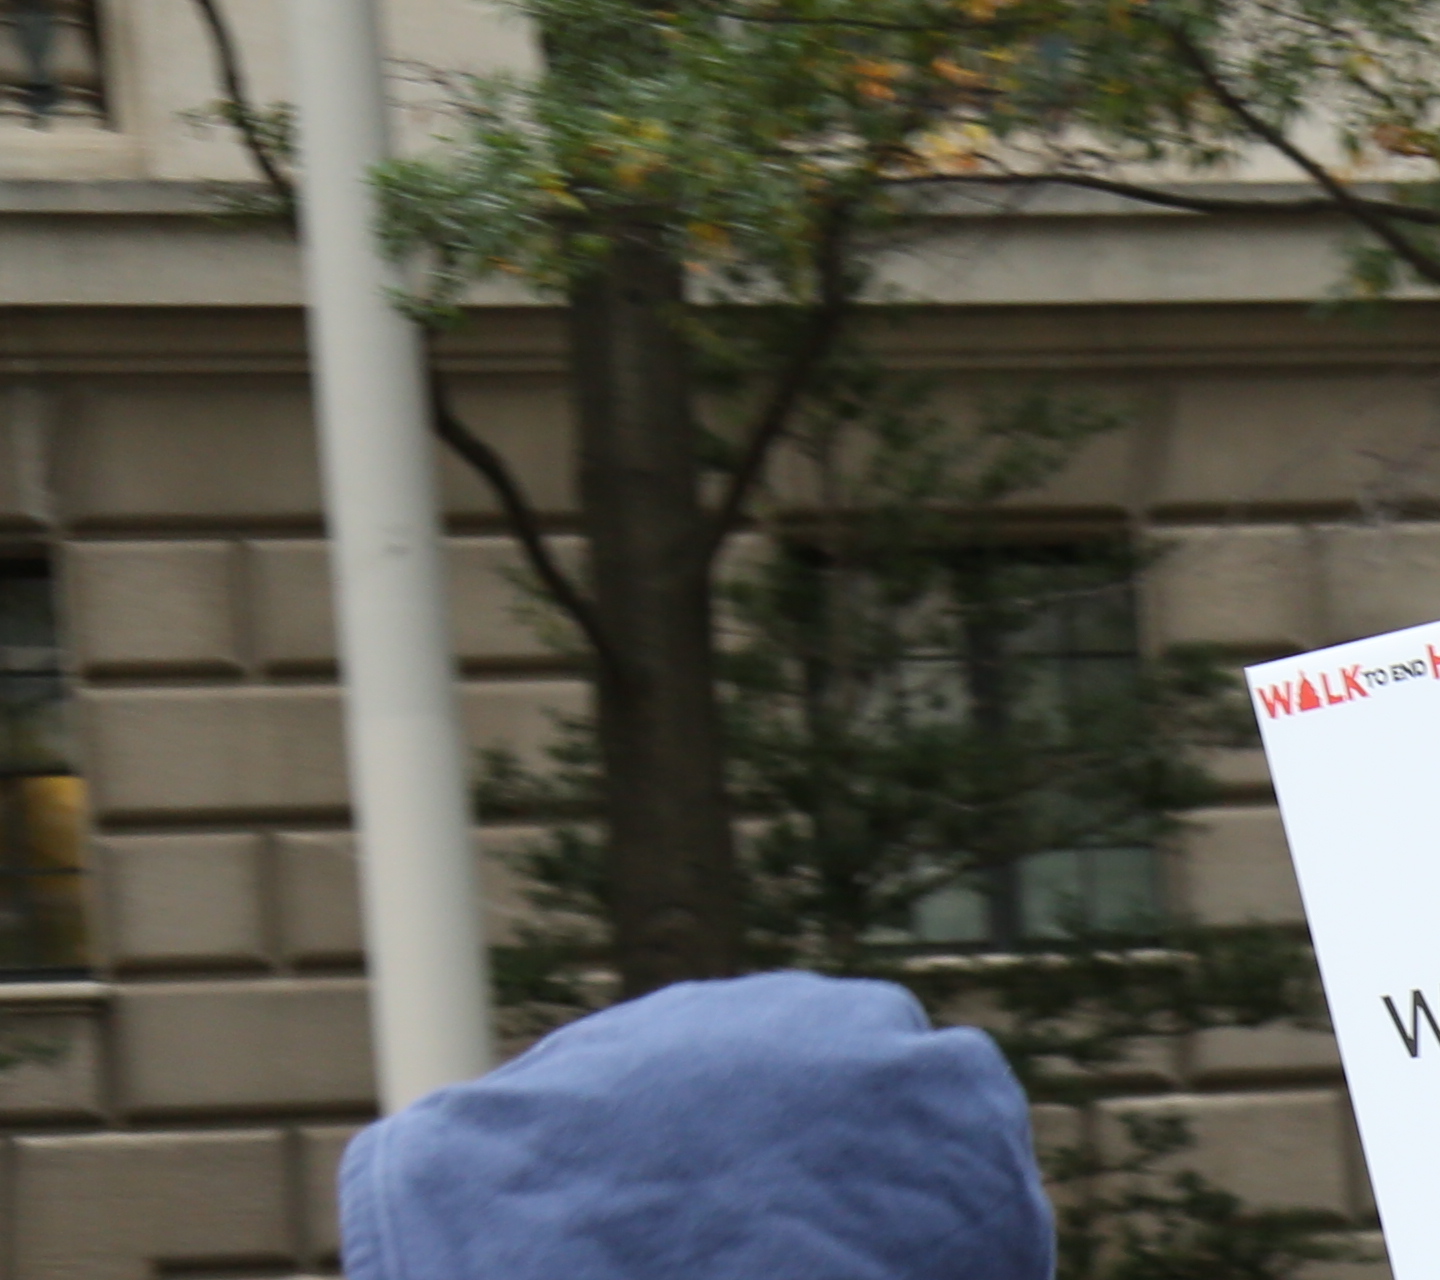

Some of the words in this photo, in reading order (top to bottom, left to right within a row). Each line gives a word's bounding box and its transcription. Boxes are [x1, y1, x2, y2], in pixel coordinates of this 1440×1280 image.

[1256, 664, 1370, 720] WALK
[1363, 667, 1390, 688] TO
[1391, 658, 1429, 683] END
